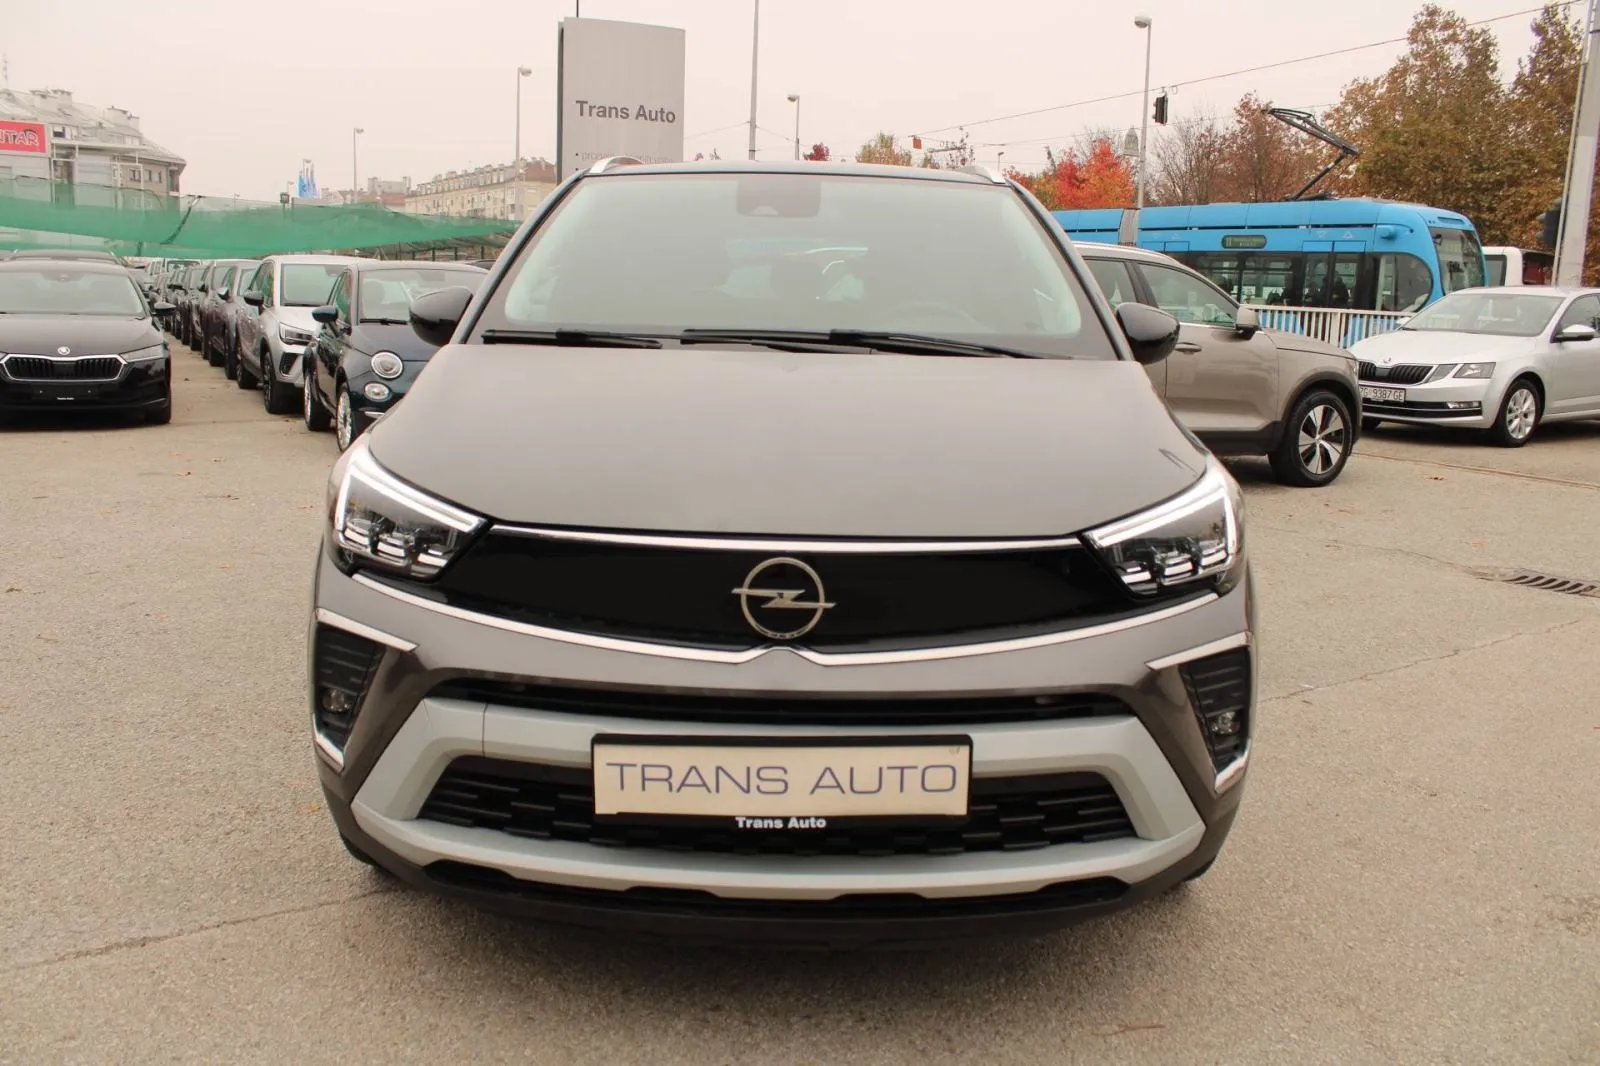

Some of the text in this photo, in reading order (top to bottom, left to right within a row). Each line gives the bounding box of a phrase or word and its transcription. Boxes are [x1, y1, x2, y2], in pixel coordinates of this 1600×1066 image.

[576, 100, 676, 124] Trans Auto
[605, 762, 958, 795] TRANS AUTO
[735, 816, 827, 829] Trans Auto
